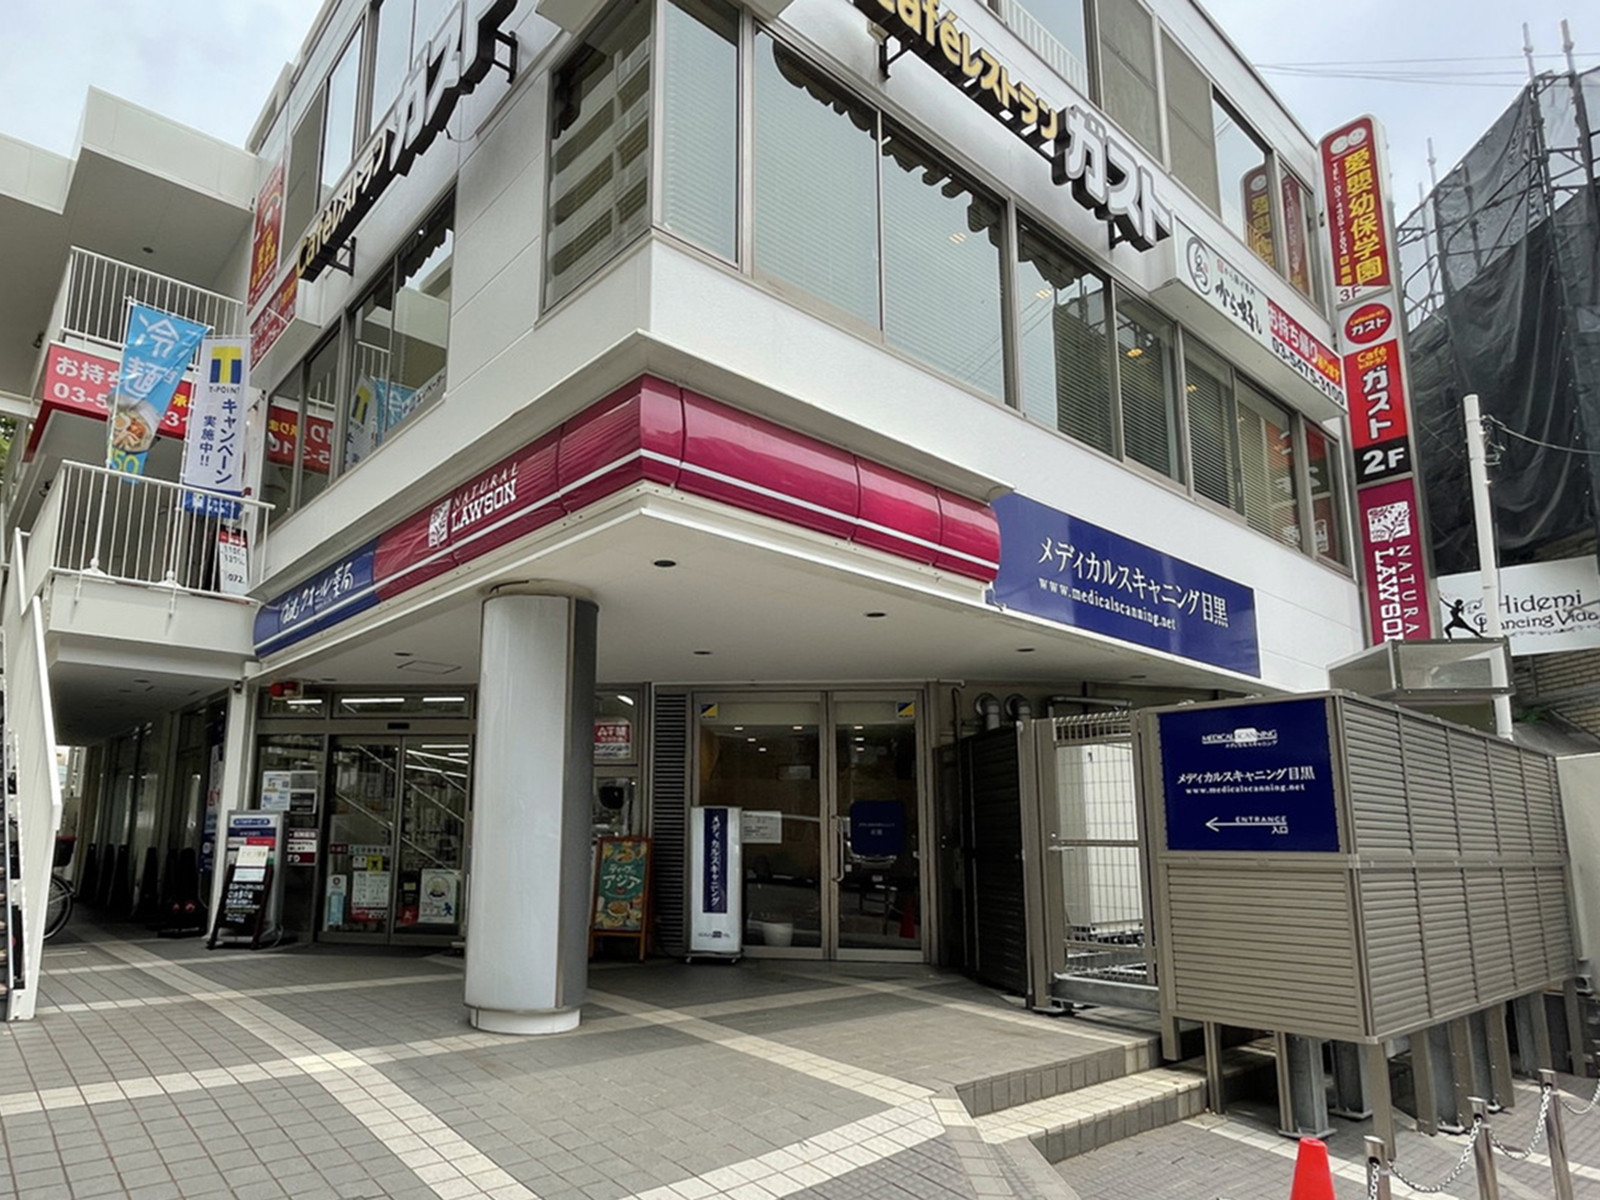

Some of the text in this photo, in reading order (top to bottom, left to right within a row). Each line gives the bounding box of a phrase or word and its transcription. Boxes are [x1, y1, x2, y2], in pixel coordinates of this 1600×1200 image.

[883, 0, 1058, 140] aféレストラン
[1065, 104, 1171, 248] ガスト
[1340, 286, 1362, 302] 3F
[1351, 318, 1387, 337] ガスト
[123, 314, 180, 397] 冷麺
[1357, 346, 1387, 363] Café
[209, 386, 240, 394] T-POINT
[1362, 364, 1392, 440] ガスト
[215, 398, 238, 484] キャンペーン
[1363, 447, 1405, 475] 2F
[453, 462, 519, 509] NATURAL
[451, 478, 517, 533] LAWSON
[1038, 537, 1229, 628] メディカルスキャニング目黒
[1038, 577, 1176, 631] www.medicalscanning.net
[1177, 765, 1315, 785] メディカルスキャニング目黒
[1185, 784, 1305, 794] www.medicalscanning.net
[1271, 826, 1288, 834] 入口
[602, 875, 642, 890] アジア
